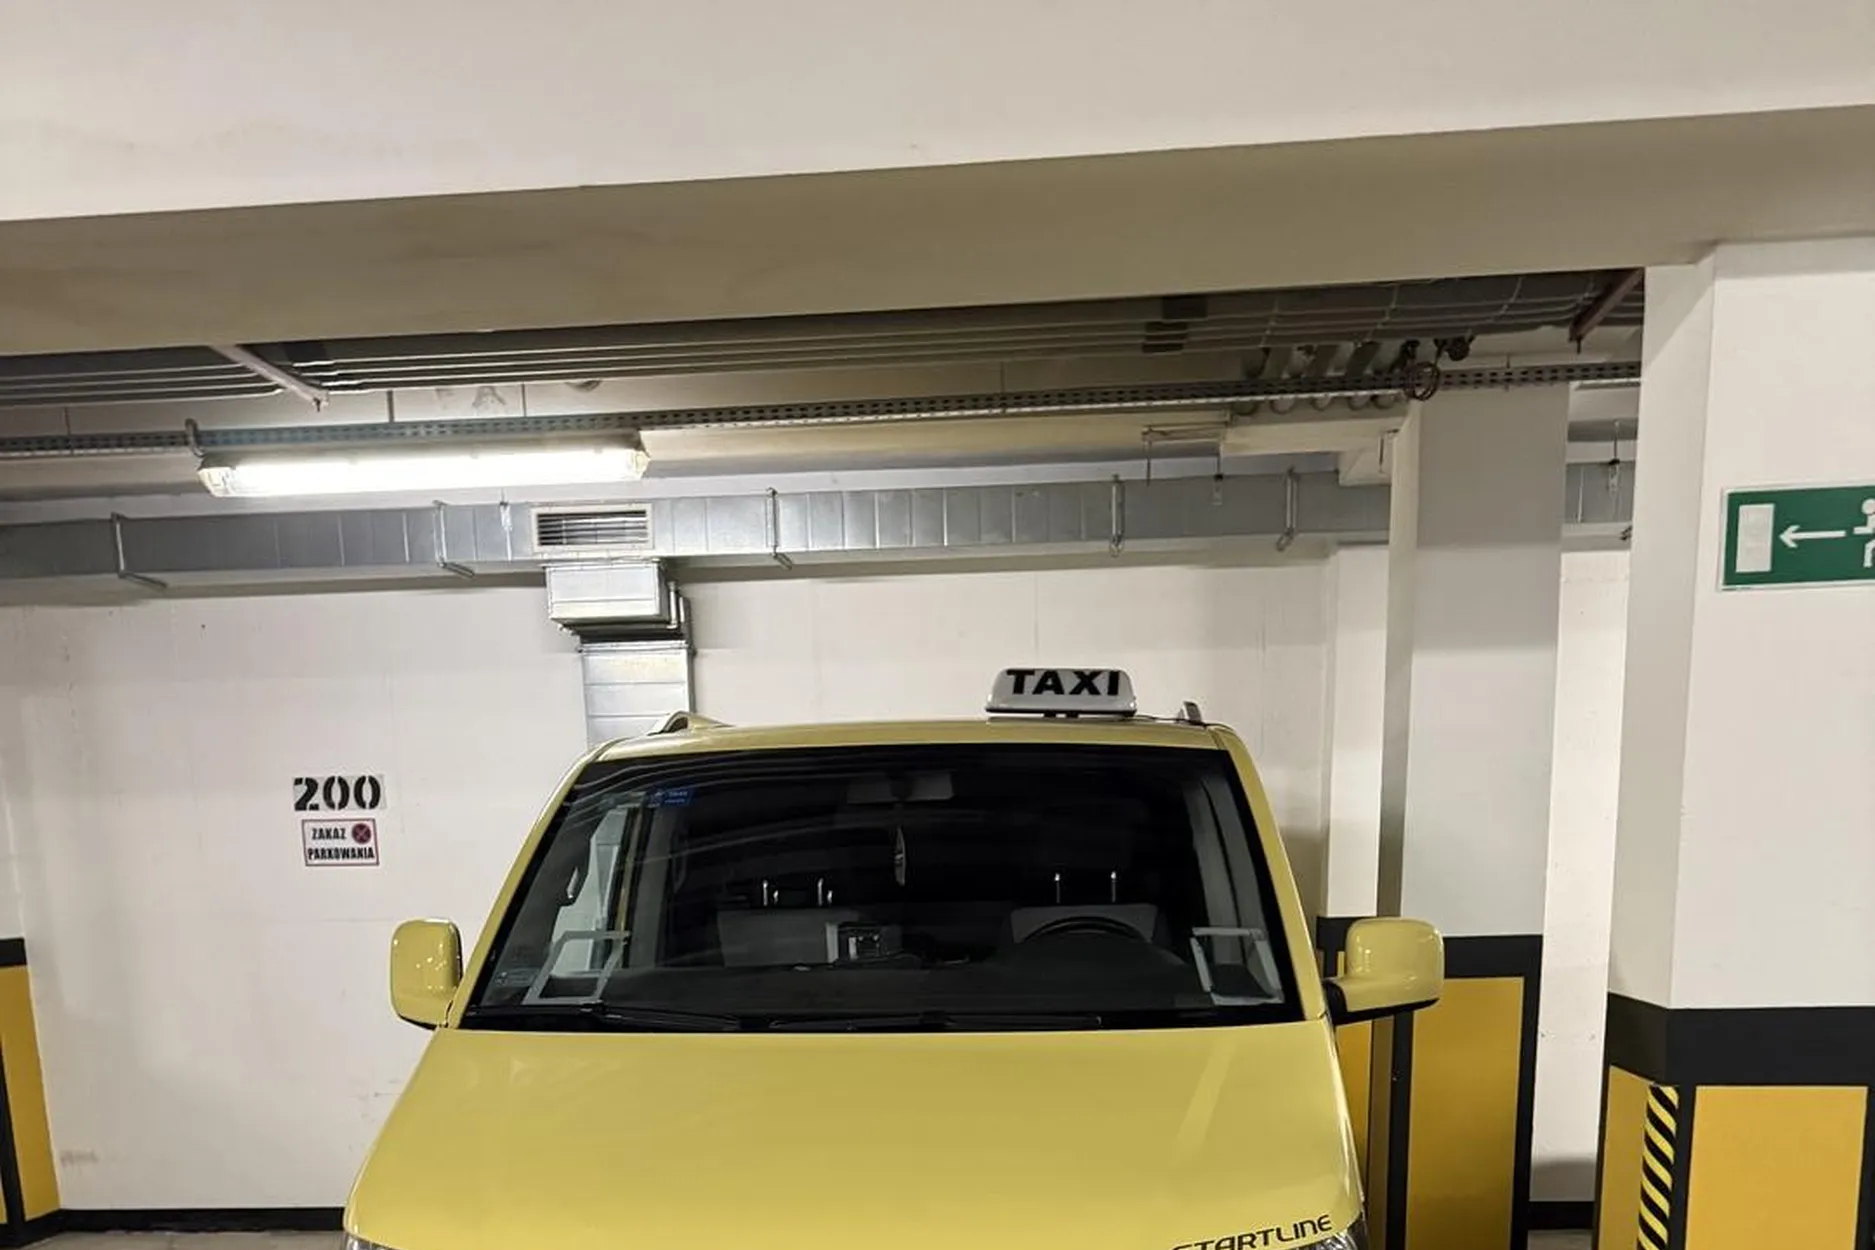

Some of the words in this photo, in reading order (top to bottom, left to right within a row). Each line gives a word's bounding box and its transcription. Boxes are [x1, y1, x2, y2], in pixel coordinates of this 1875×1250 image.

[1006, 669, 1121, 696] TAXI
[293, 775, 381, 811] 200
[311, 826, 347, 840] ZAKAZ
[307, 846, 375, 860] PARKOWANIA
